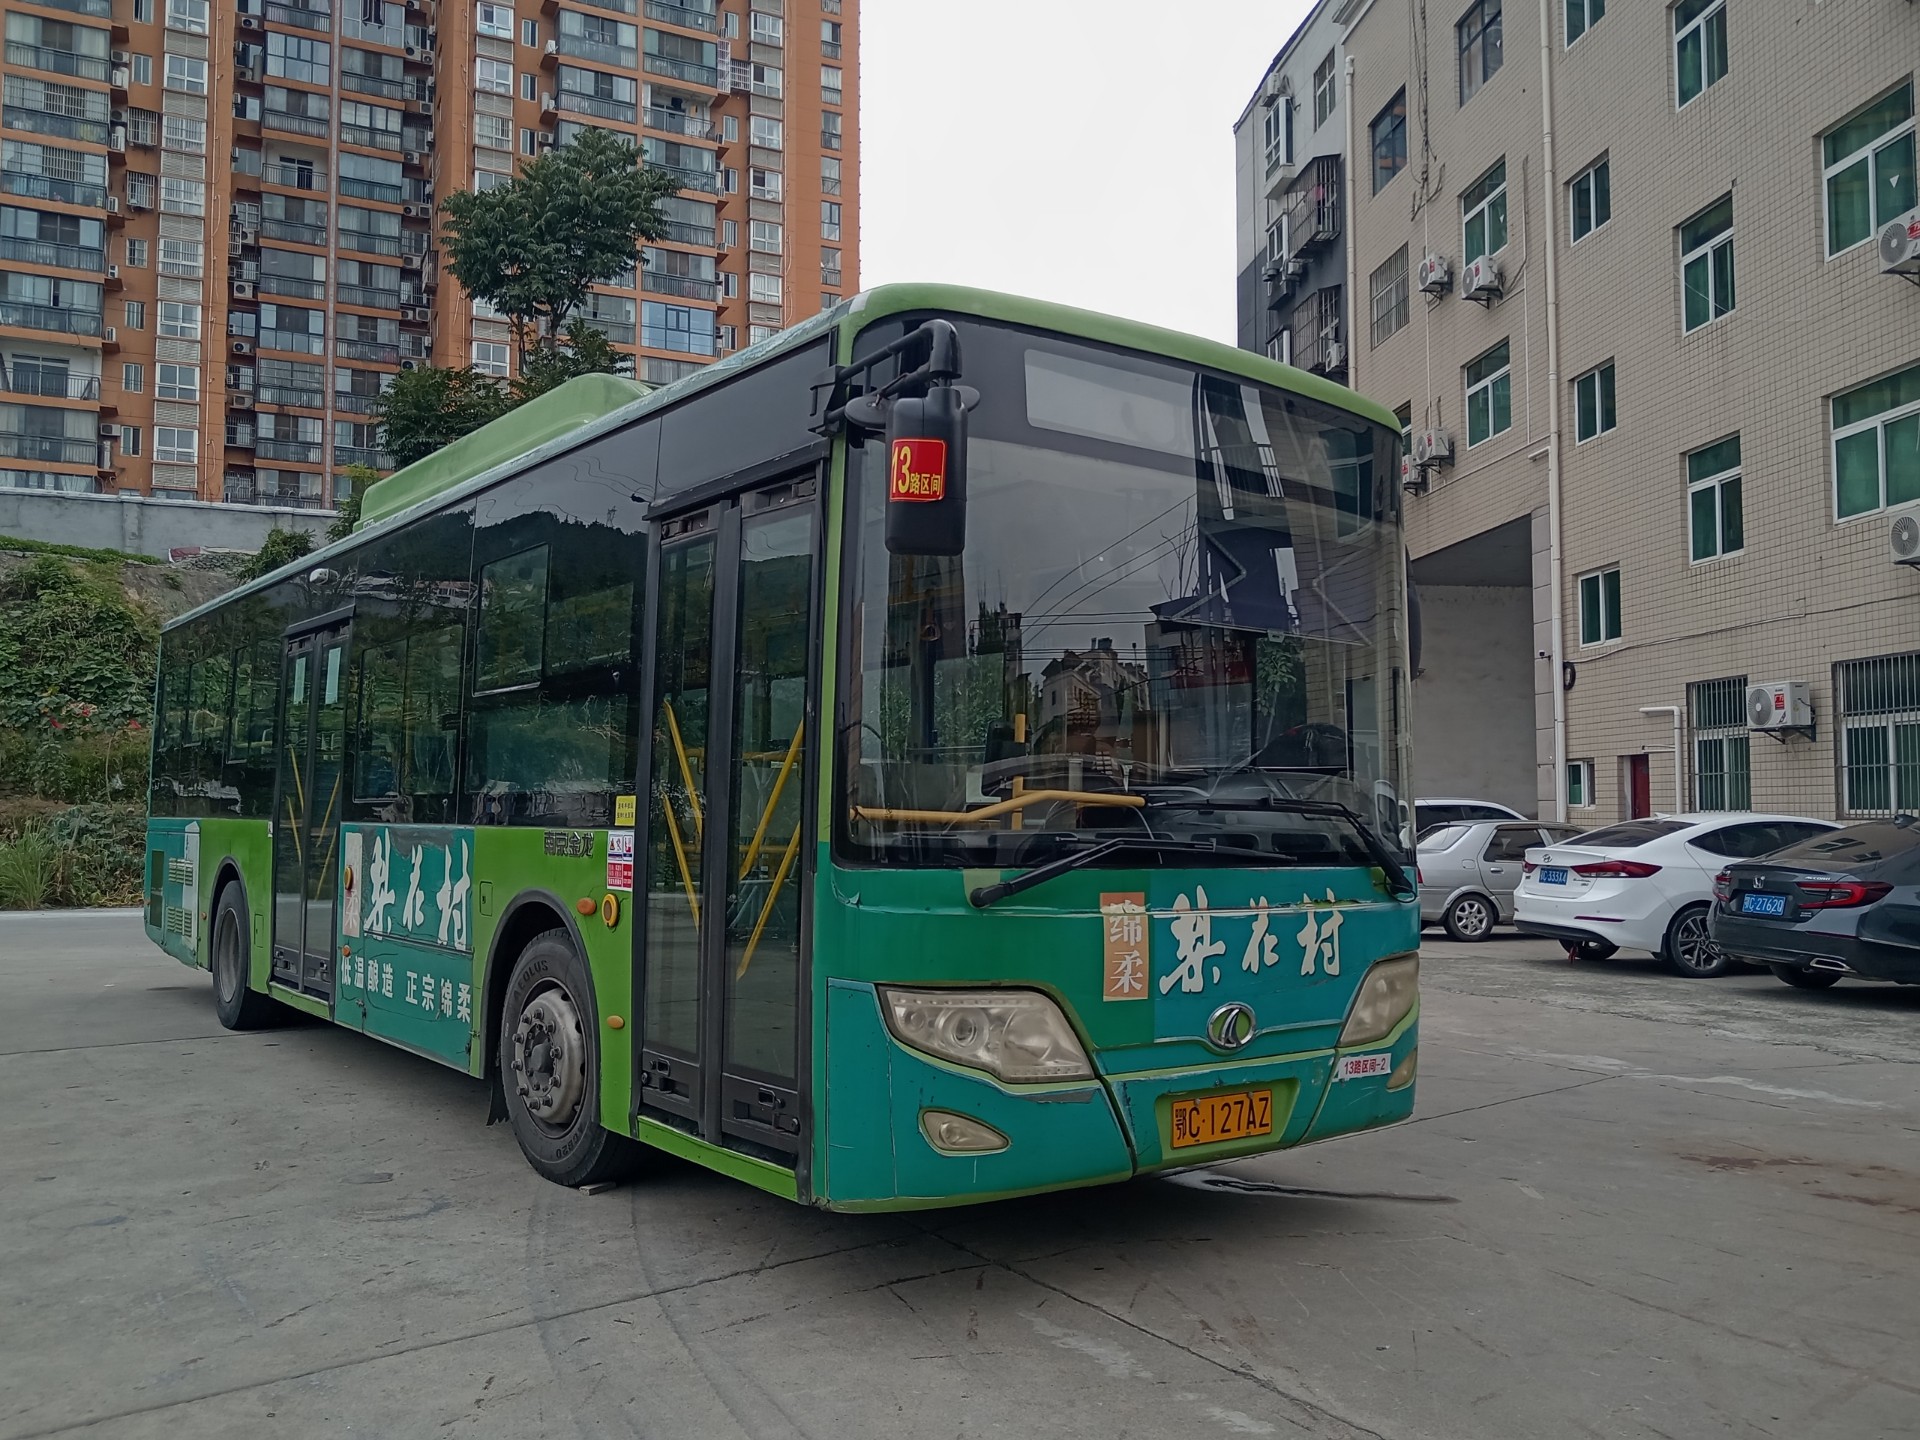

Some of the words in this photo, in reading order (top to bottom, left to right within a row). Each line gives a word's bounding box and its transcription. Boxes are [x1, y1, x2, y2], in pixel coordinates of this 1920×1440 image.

[892, 445, 941, 495] 13路区间
[544, 831, 594, 858] 南京金龙
[1110, 899, 1144, 994] 绵柔
[341, 954, 394, 999] 低温酿造
[405, 970, 471, 1024] 正宗绵柔
[1344, 1057, 1386, 1075] 13路区间-2
